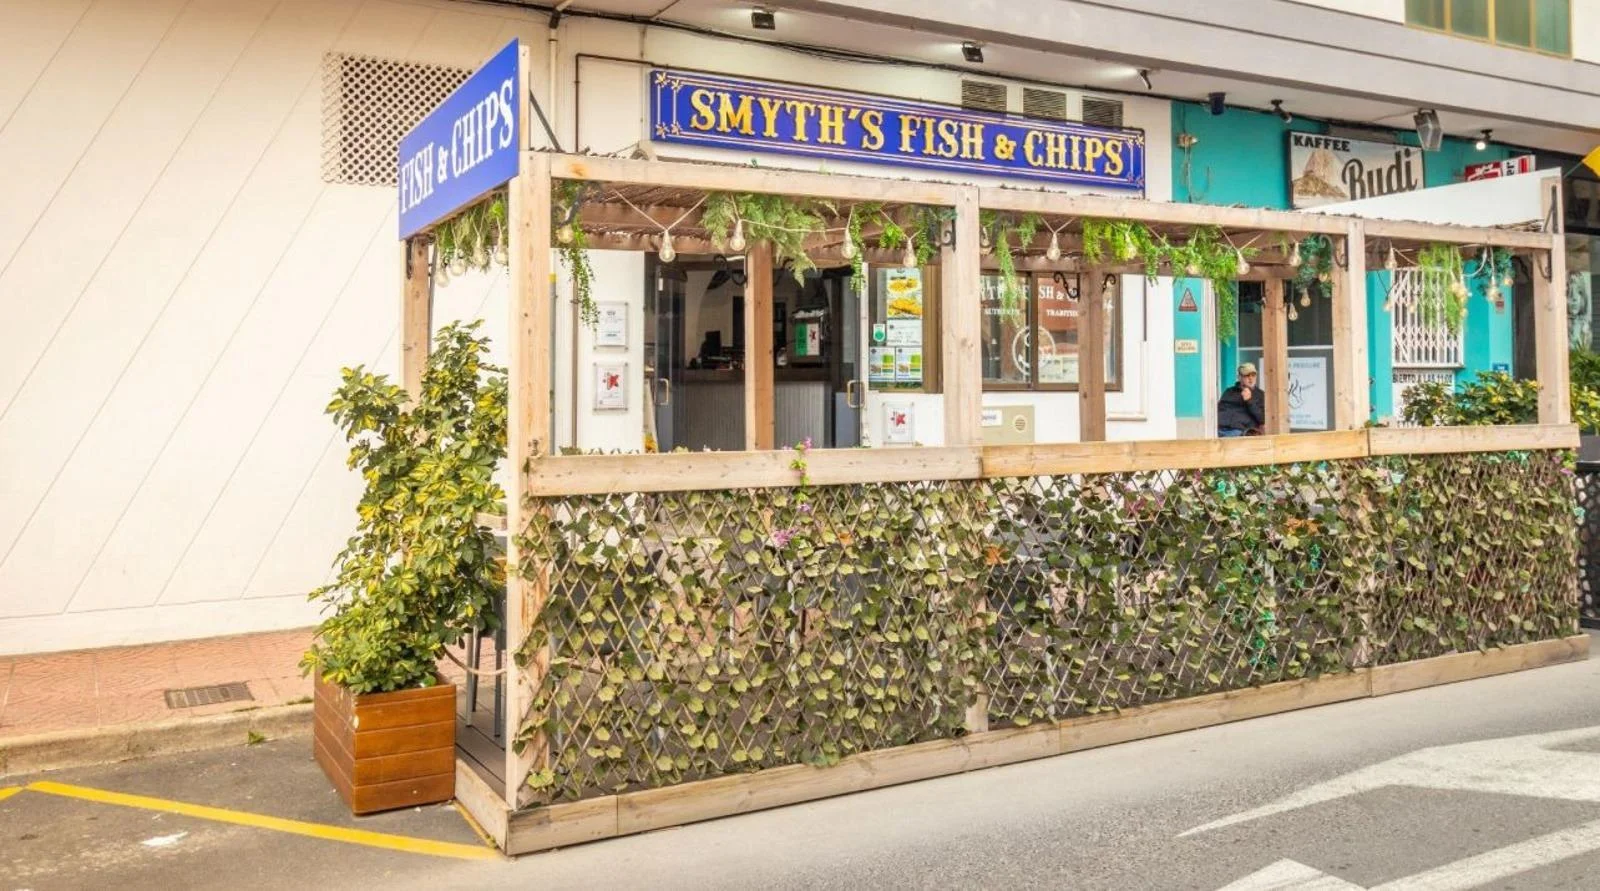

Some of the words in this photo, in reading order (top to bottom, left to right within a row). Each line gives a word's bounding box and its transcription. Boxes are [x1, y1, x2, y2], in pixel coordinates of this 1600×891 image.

[401, 141, 434, 214] FISH
[437, 145, 449, 184] &
[451, 76, 514, 178] CHIPS
[690, 88, 885, 151] SMYTH'S
[898, 114, 985, 160] FISH
[994, 134, 1016, 160] &
[1023, 130, 1124, 176] CHIPS
[1294, 133, 1351, 152] KAFFEE
[1022, 284, 1053, 299] FSH
